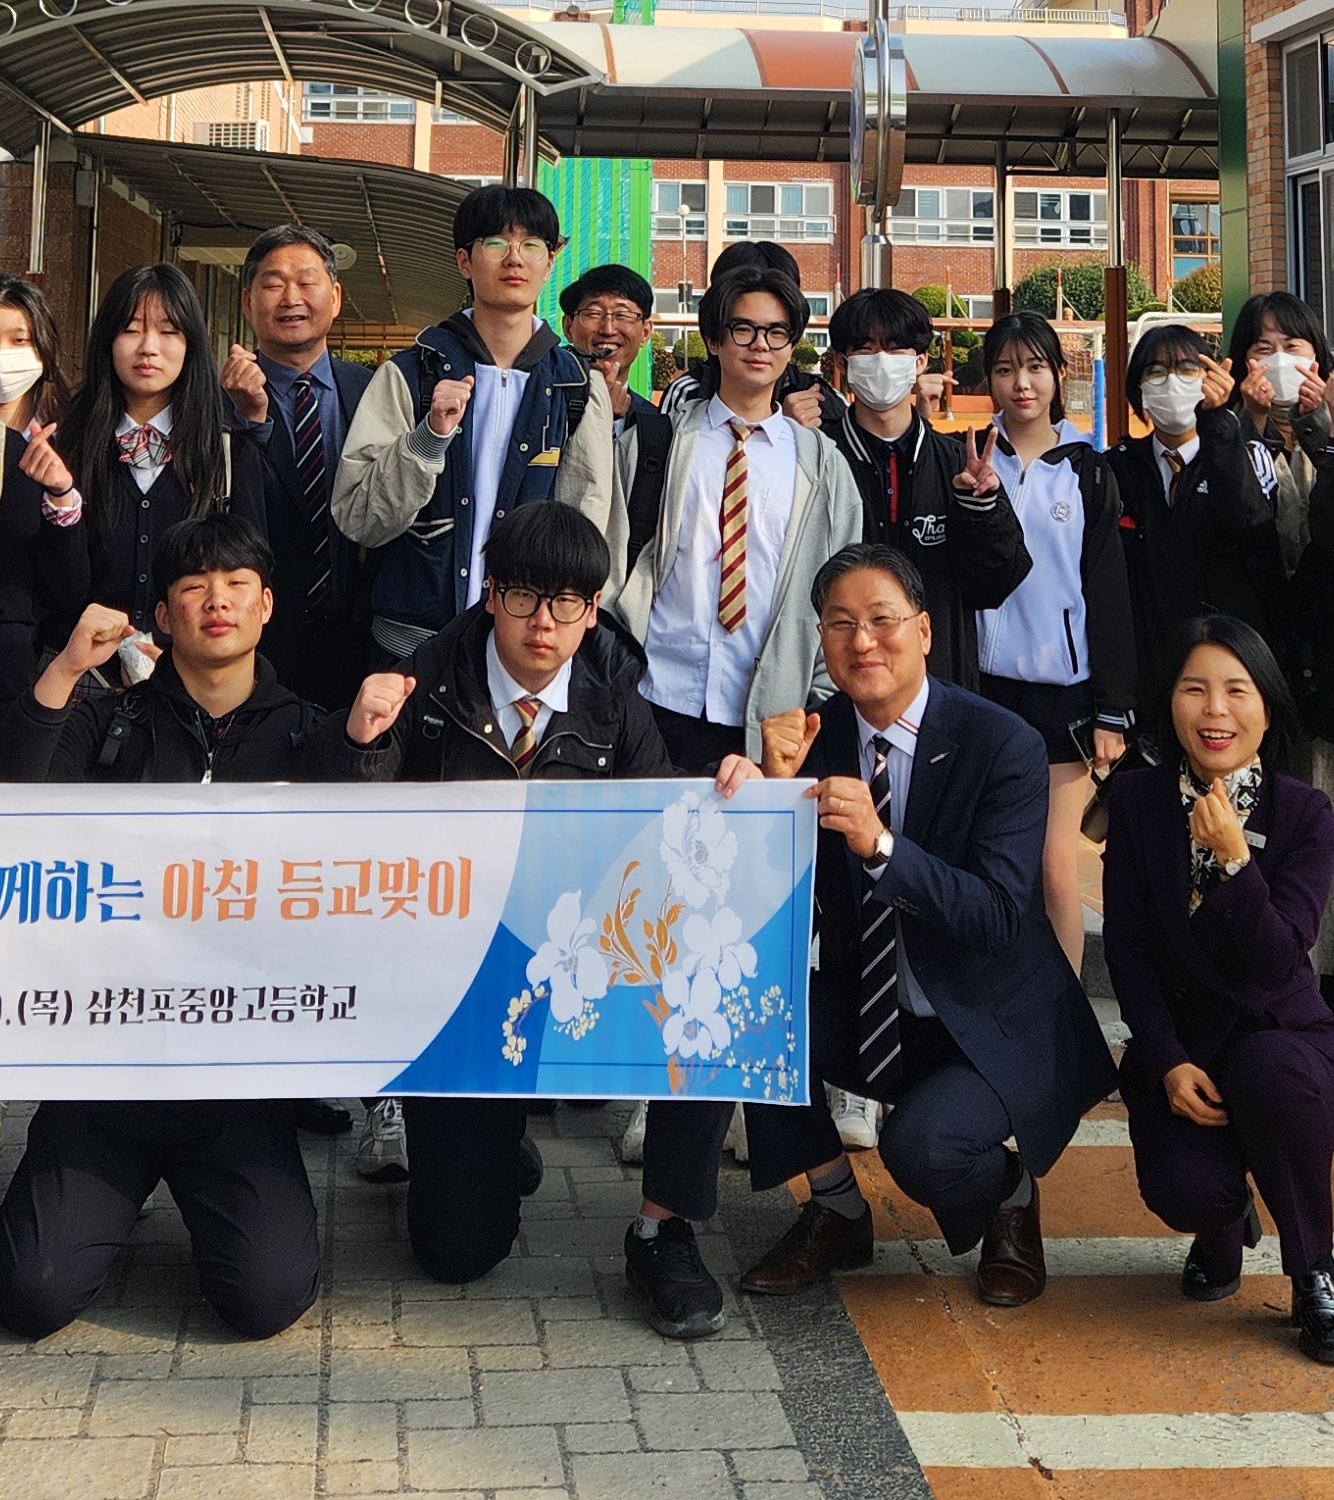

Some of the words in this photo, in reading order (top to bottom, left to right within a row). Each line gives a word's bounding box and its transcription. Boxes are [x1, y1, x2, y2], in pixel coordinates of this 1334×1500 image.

[912, 514, 947, 546] Tha
[163, 860, 260, 923] 아침
[279, 858, 474, 922] 등교맞이
[86, 984, 358, 1026] 삼천포중앙고등학교
